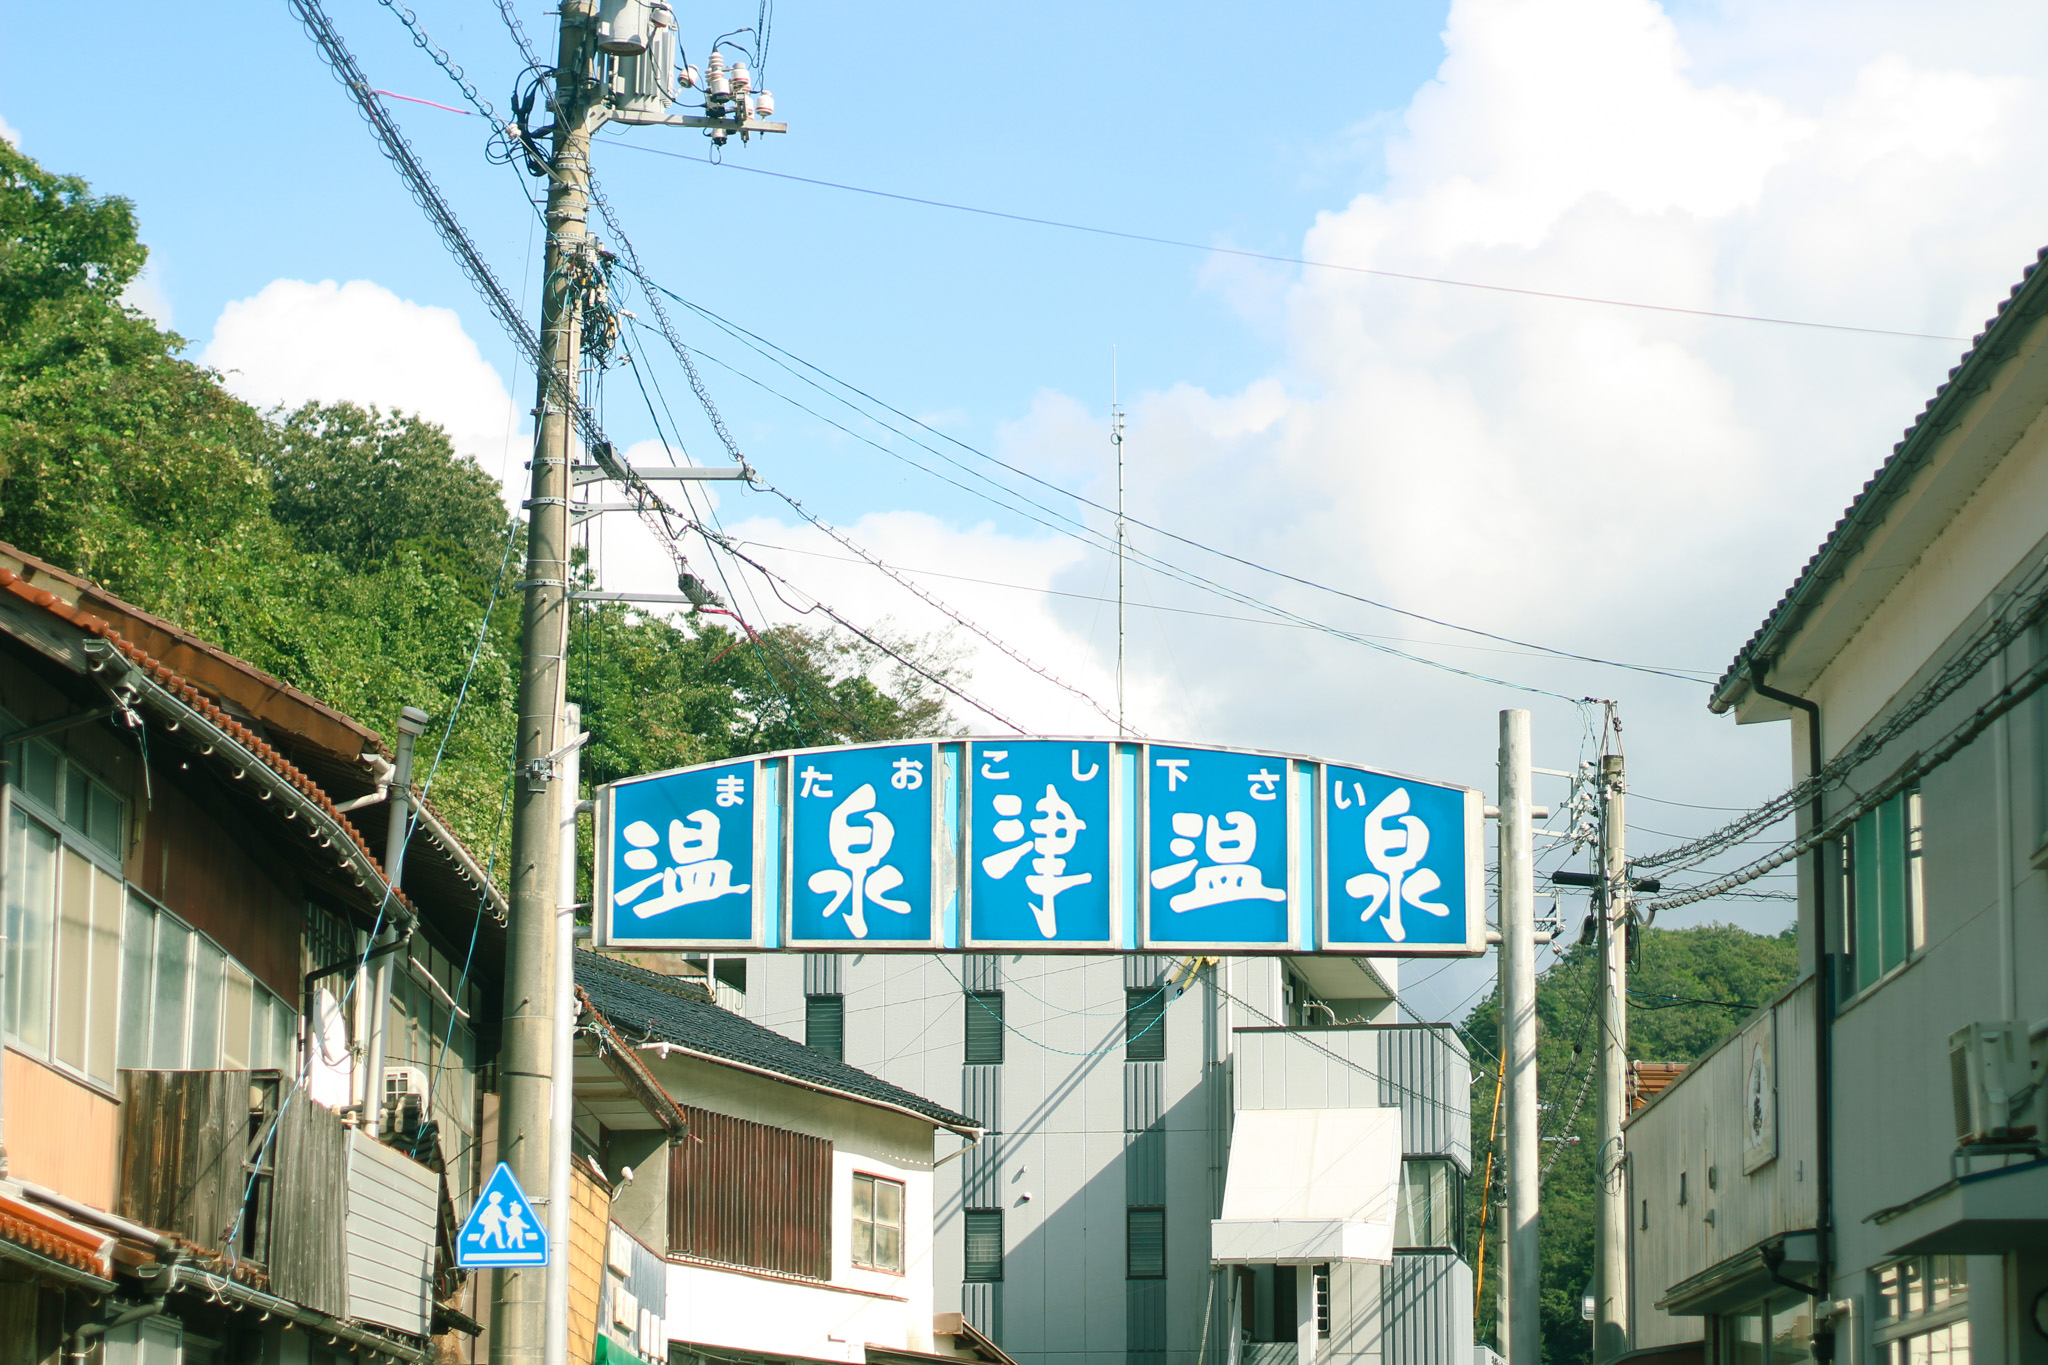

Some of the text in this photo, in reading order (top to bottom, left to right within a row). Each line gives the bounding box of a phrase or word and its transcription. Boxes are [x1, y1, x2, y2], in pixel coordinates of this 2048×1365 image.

[715, 749, 1367, 809] またおこし下さい
[614, 783, 1450, 942] 温泉津温泉
